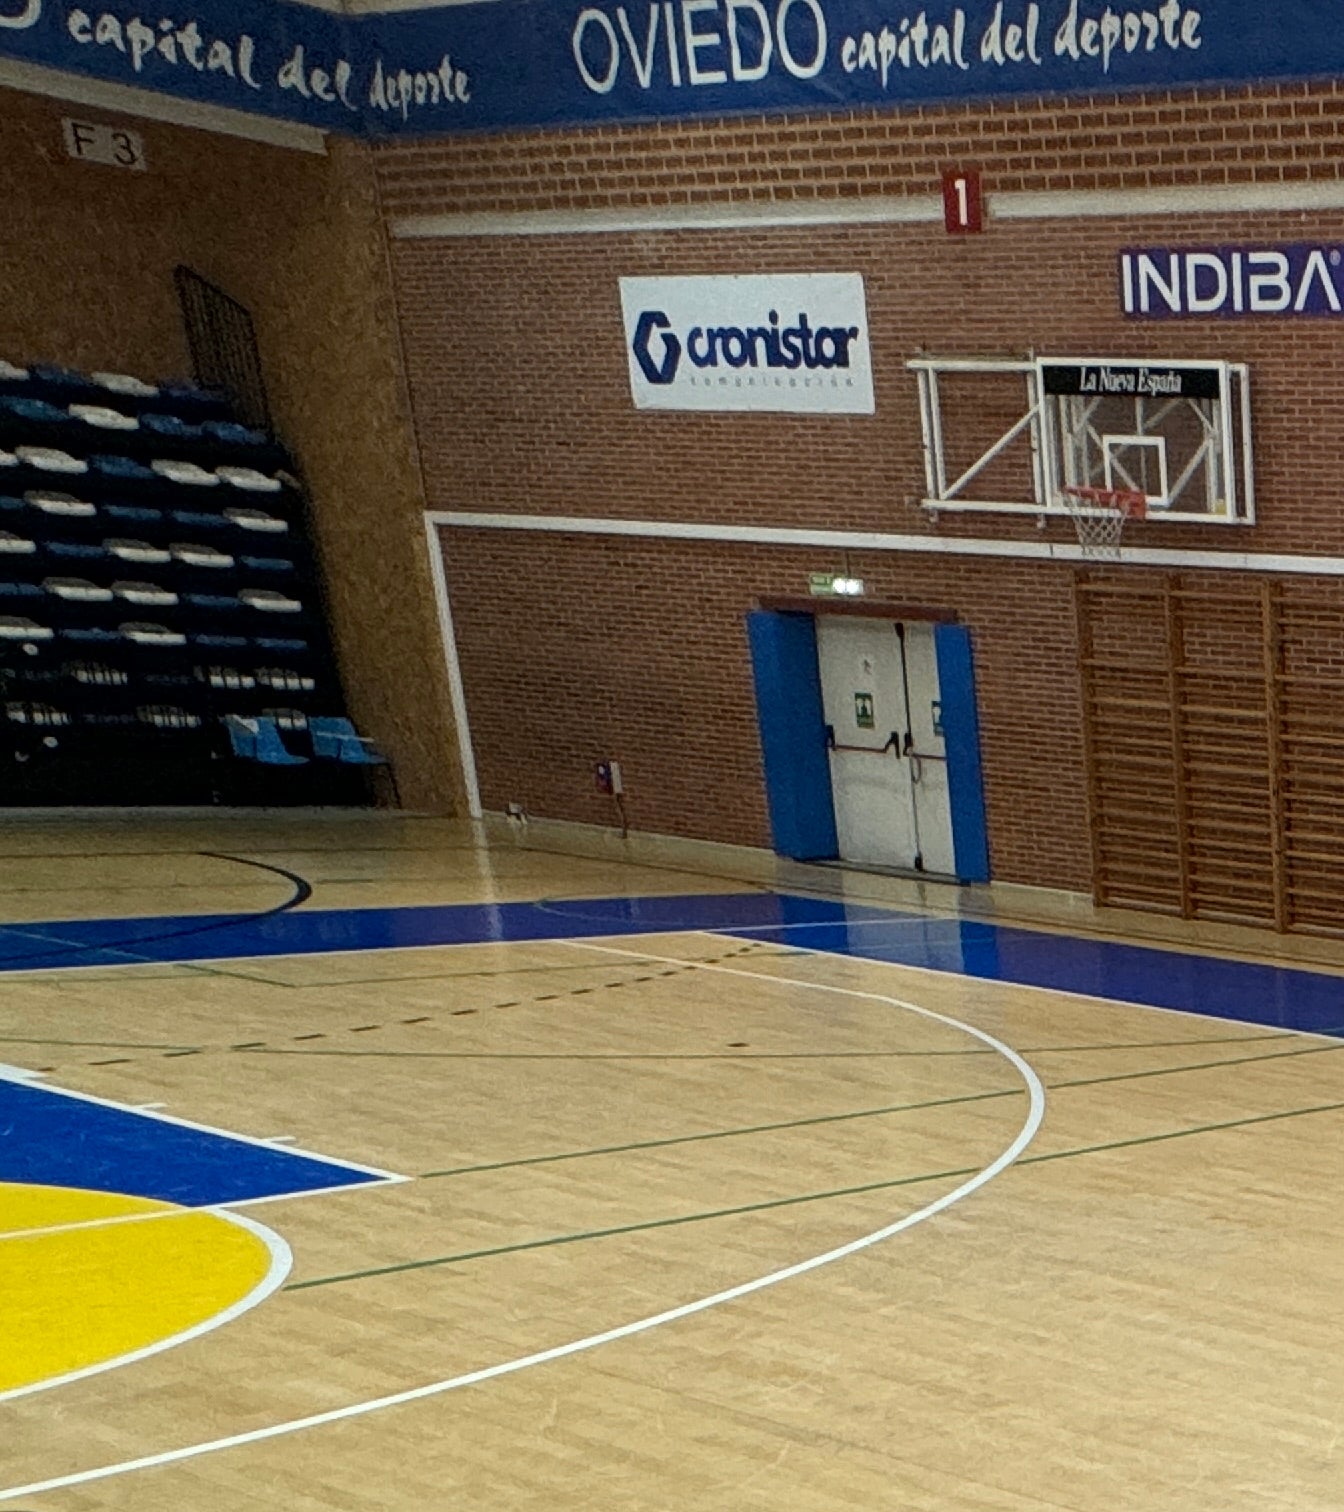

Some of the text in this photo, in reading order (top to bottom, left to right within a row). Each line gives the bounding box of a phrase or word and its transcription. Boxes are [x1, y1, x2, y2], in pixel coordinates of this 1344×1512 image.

[68, 8, 260, 89] capital
[278, 45, 358, 111] del
[369, 55, 471, 119] deporte
[573, 0, 1202, 94] OVIEDO capital del deporte
[954, 178, 969, 226] 1
[686, 309, 859, 369] cronistar
[1079, 367, 1097, 391] La
[1099, 366, 1136, 393] Nueva
